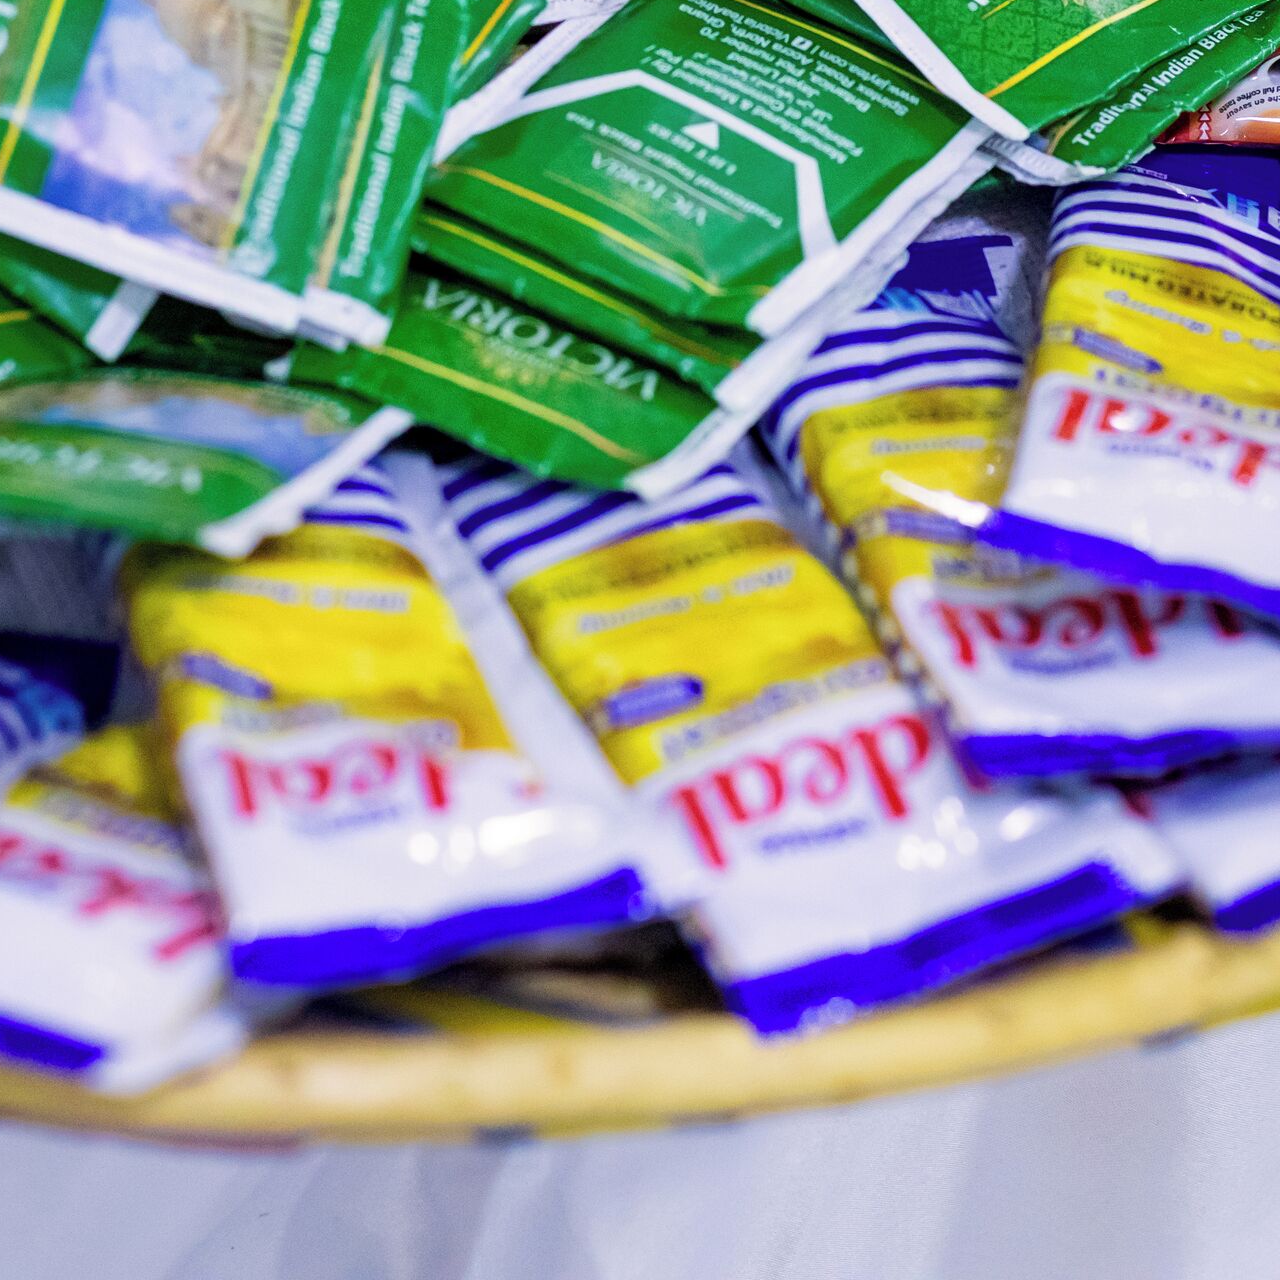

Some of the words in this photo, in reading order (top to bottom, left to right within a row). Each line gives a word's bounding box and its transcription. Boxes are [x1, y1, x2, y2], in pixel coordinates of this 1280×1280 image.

[1150, 47, 1205, 87] Indian
[1197, 21, 1246, 51] Black
[1235, 87, 1262, 103] coffee
[1260, 85, 1276, 96] full
[1217, 95, 1236, 115] taste
[1225, 100, 1253, 121] saveur
[1252, 97, 1266, 108] en
[420, 280, 662, 401] VICTORIA
[669, 713, 933, 876] deal
